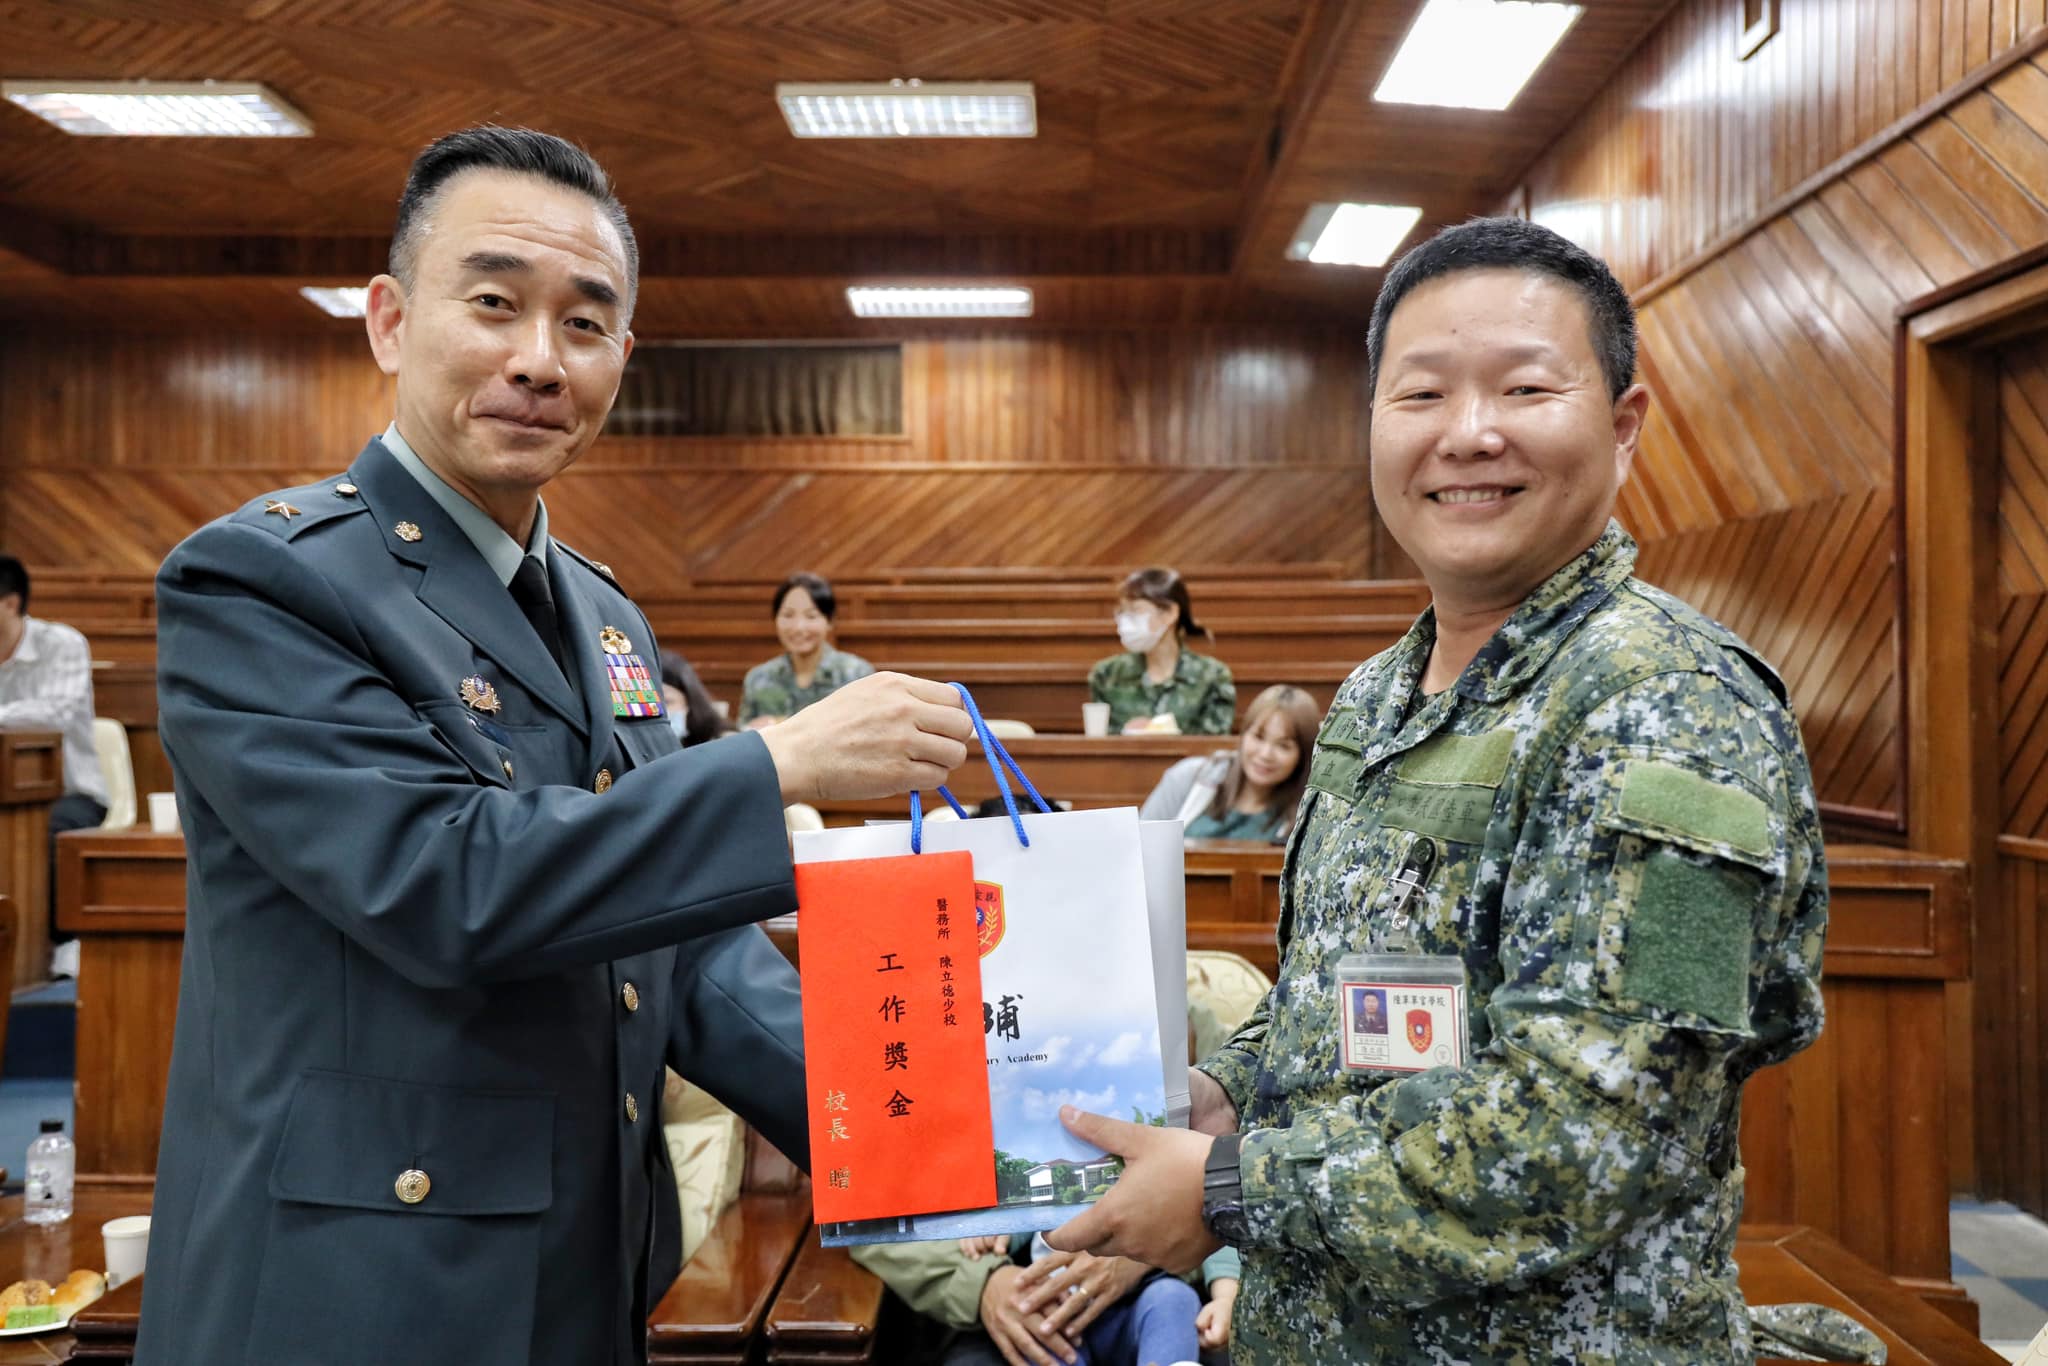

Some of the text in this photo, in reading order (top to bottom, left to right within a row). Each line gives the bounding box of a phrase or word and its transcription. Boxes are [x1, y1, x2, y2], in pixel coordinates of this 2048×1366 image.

[936, 898, 957, 1026] 醫務所 陳立德少校
[876, 953, 915, 1118] 工作獎金
[1007, 1053, 1048, 1064] Academy
[824, 1089, 850, 1190] 校長 贈
